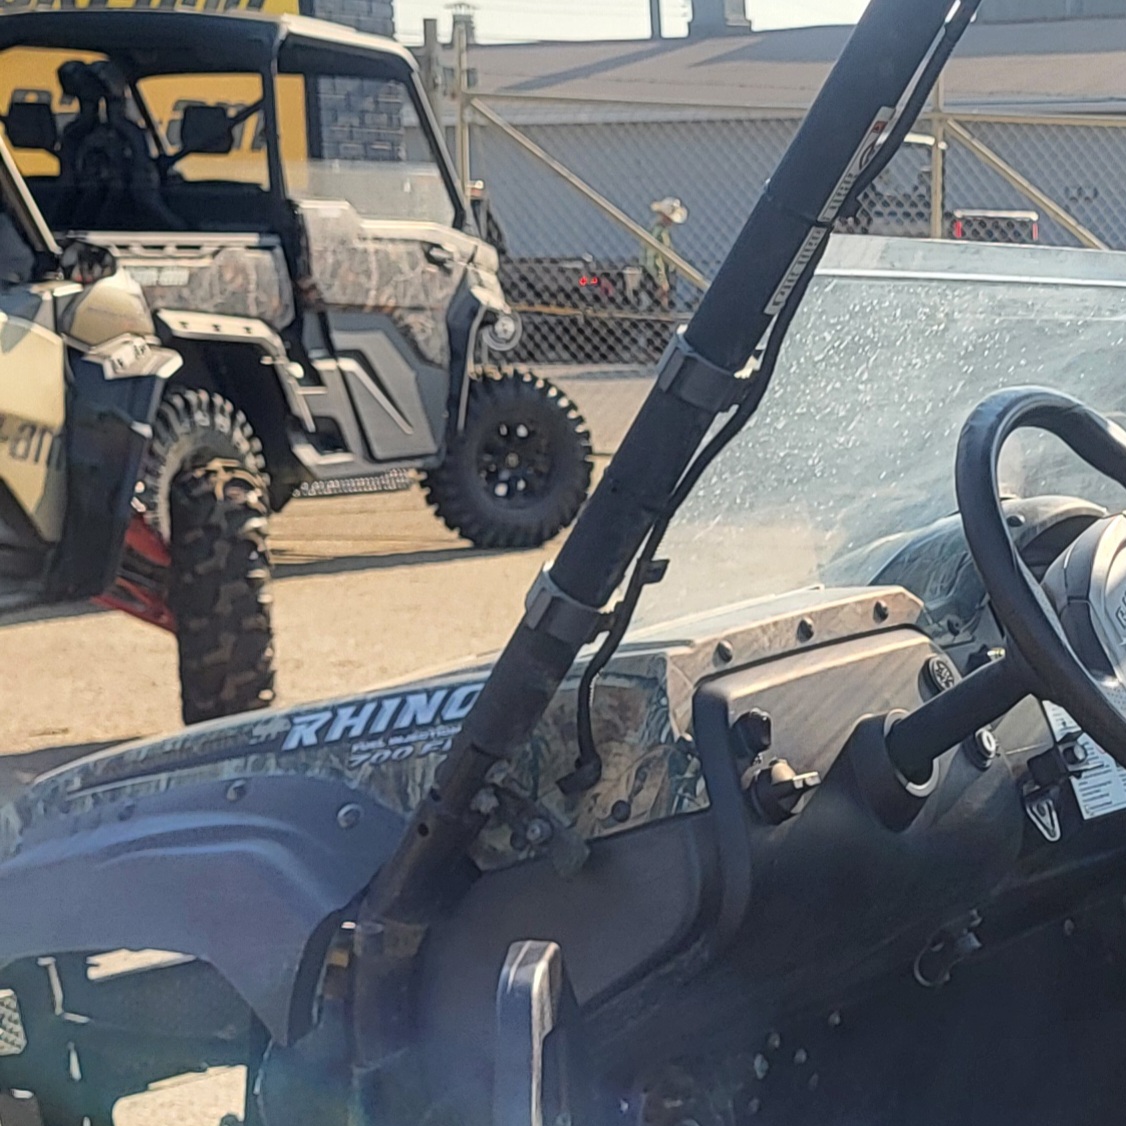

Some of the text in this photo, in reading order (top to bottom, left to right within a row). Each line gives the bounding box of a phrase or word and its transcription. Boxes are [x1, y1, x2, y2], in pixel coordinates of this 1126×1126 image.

[282, 683, 485, 750] RHINO
[350, 739, 452, 768] 700 FI
